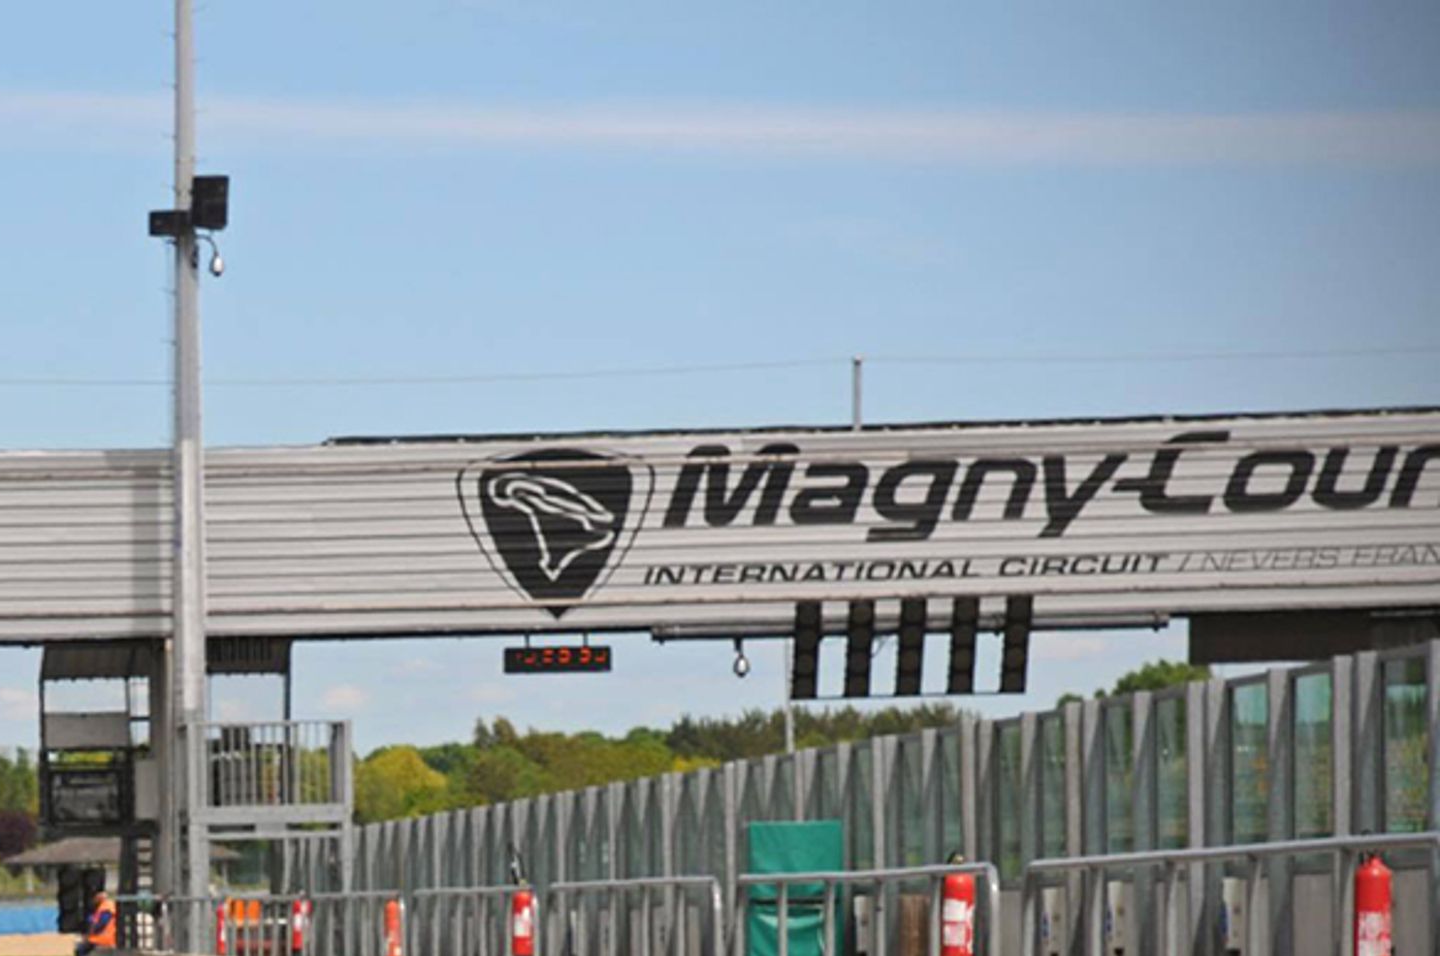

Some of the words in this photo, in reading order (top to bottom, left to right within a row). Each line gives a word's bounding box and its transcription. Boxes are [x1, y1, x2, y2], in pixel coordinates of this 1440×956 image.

[644, 559, 980, 586] INTERNATIONAL
[998, 552, 1170, 577] CIRCUIT
[1200, 546, 1340, 571] NEVERS
